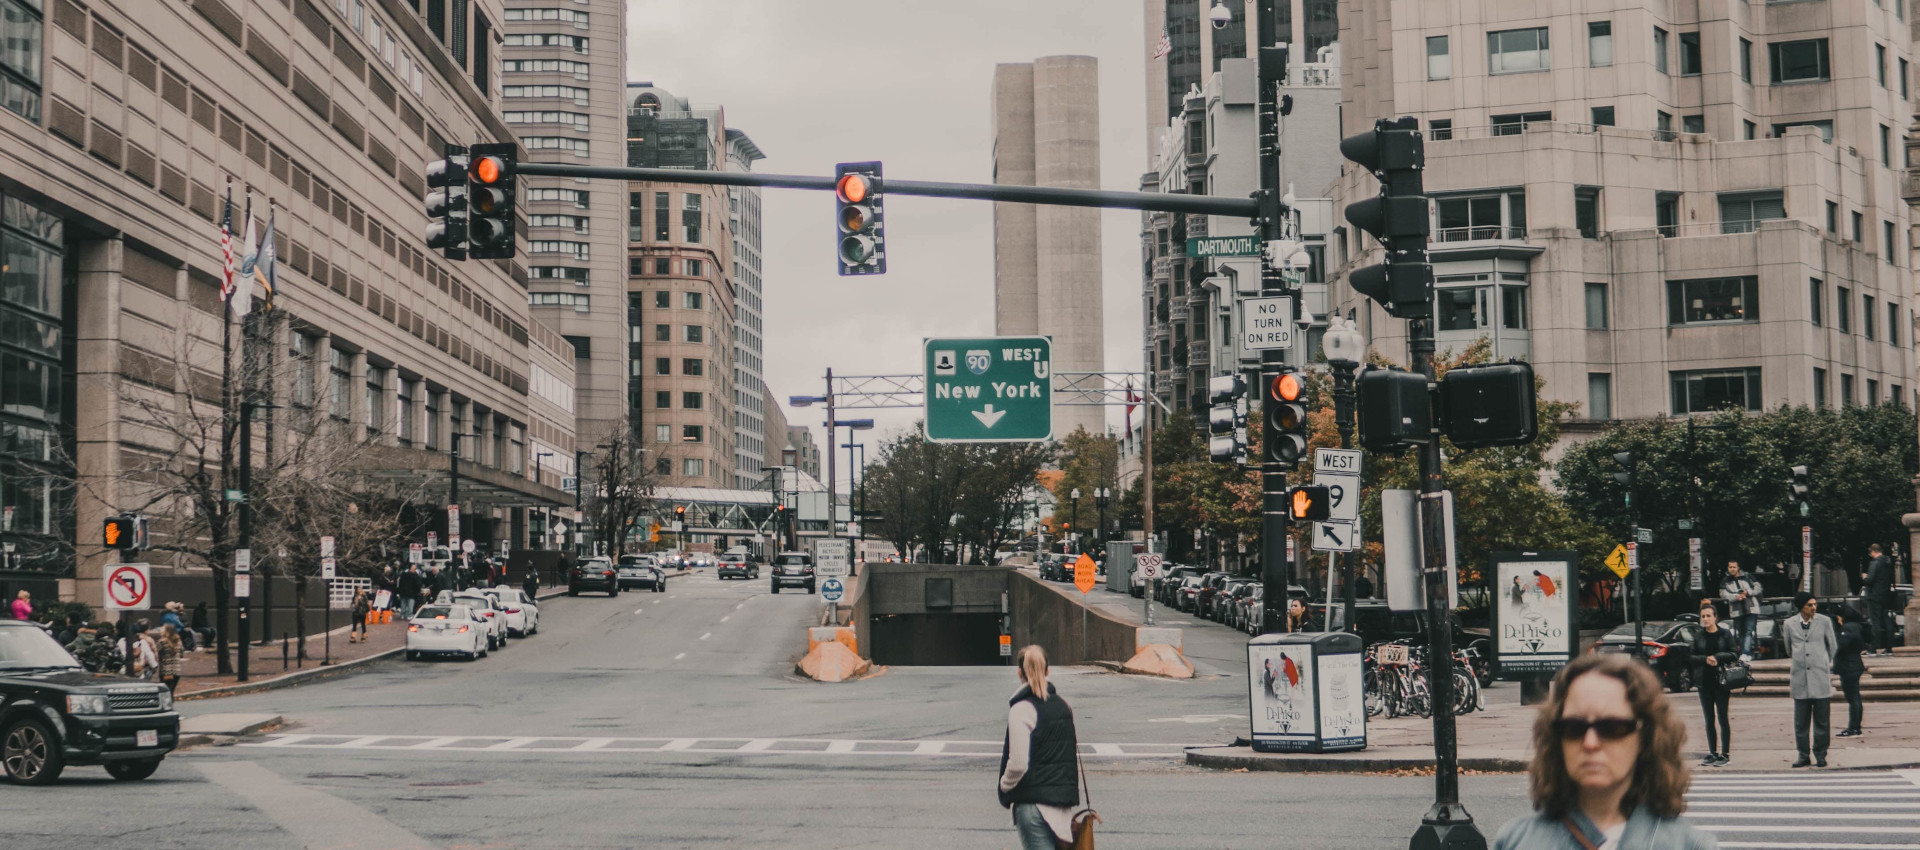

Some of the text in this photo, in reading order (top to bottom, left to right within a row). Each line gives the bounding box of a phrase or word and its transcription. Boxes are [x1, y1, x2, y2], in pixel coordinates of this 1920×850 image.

[1197, 238, 1252, 255] DARTMOUTH
[1258, 303, 1277, 314] NO
[1254, 318, 1282, 328] TURN
[1248, 332, 1289, 343] ON RED
[967, 348, 1042, 370] 90 WEST
[935, 381, 1041, 399] New York
[1322, 453, 1354, 469] WEST
[1330, 484, 1344, 509] 9
[1504, 623, 1562, 639] DePrisco
[1266, 706, 1301, 721] DePrisco
[1324, 715, 1360, 727] DePrisco
